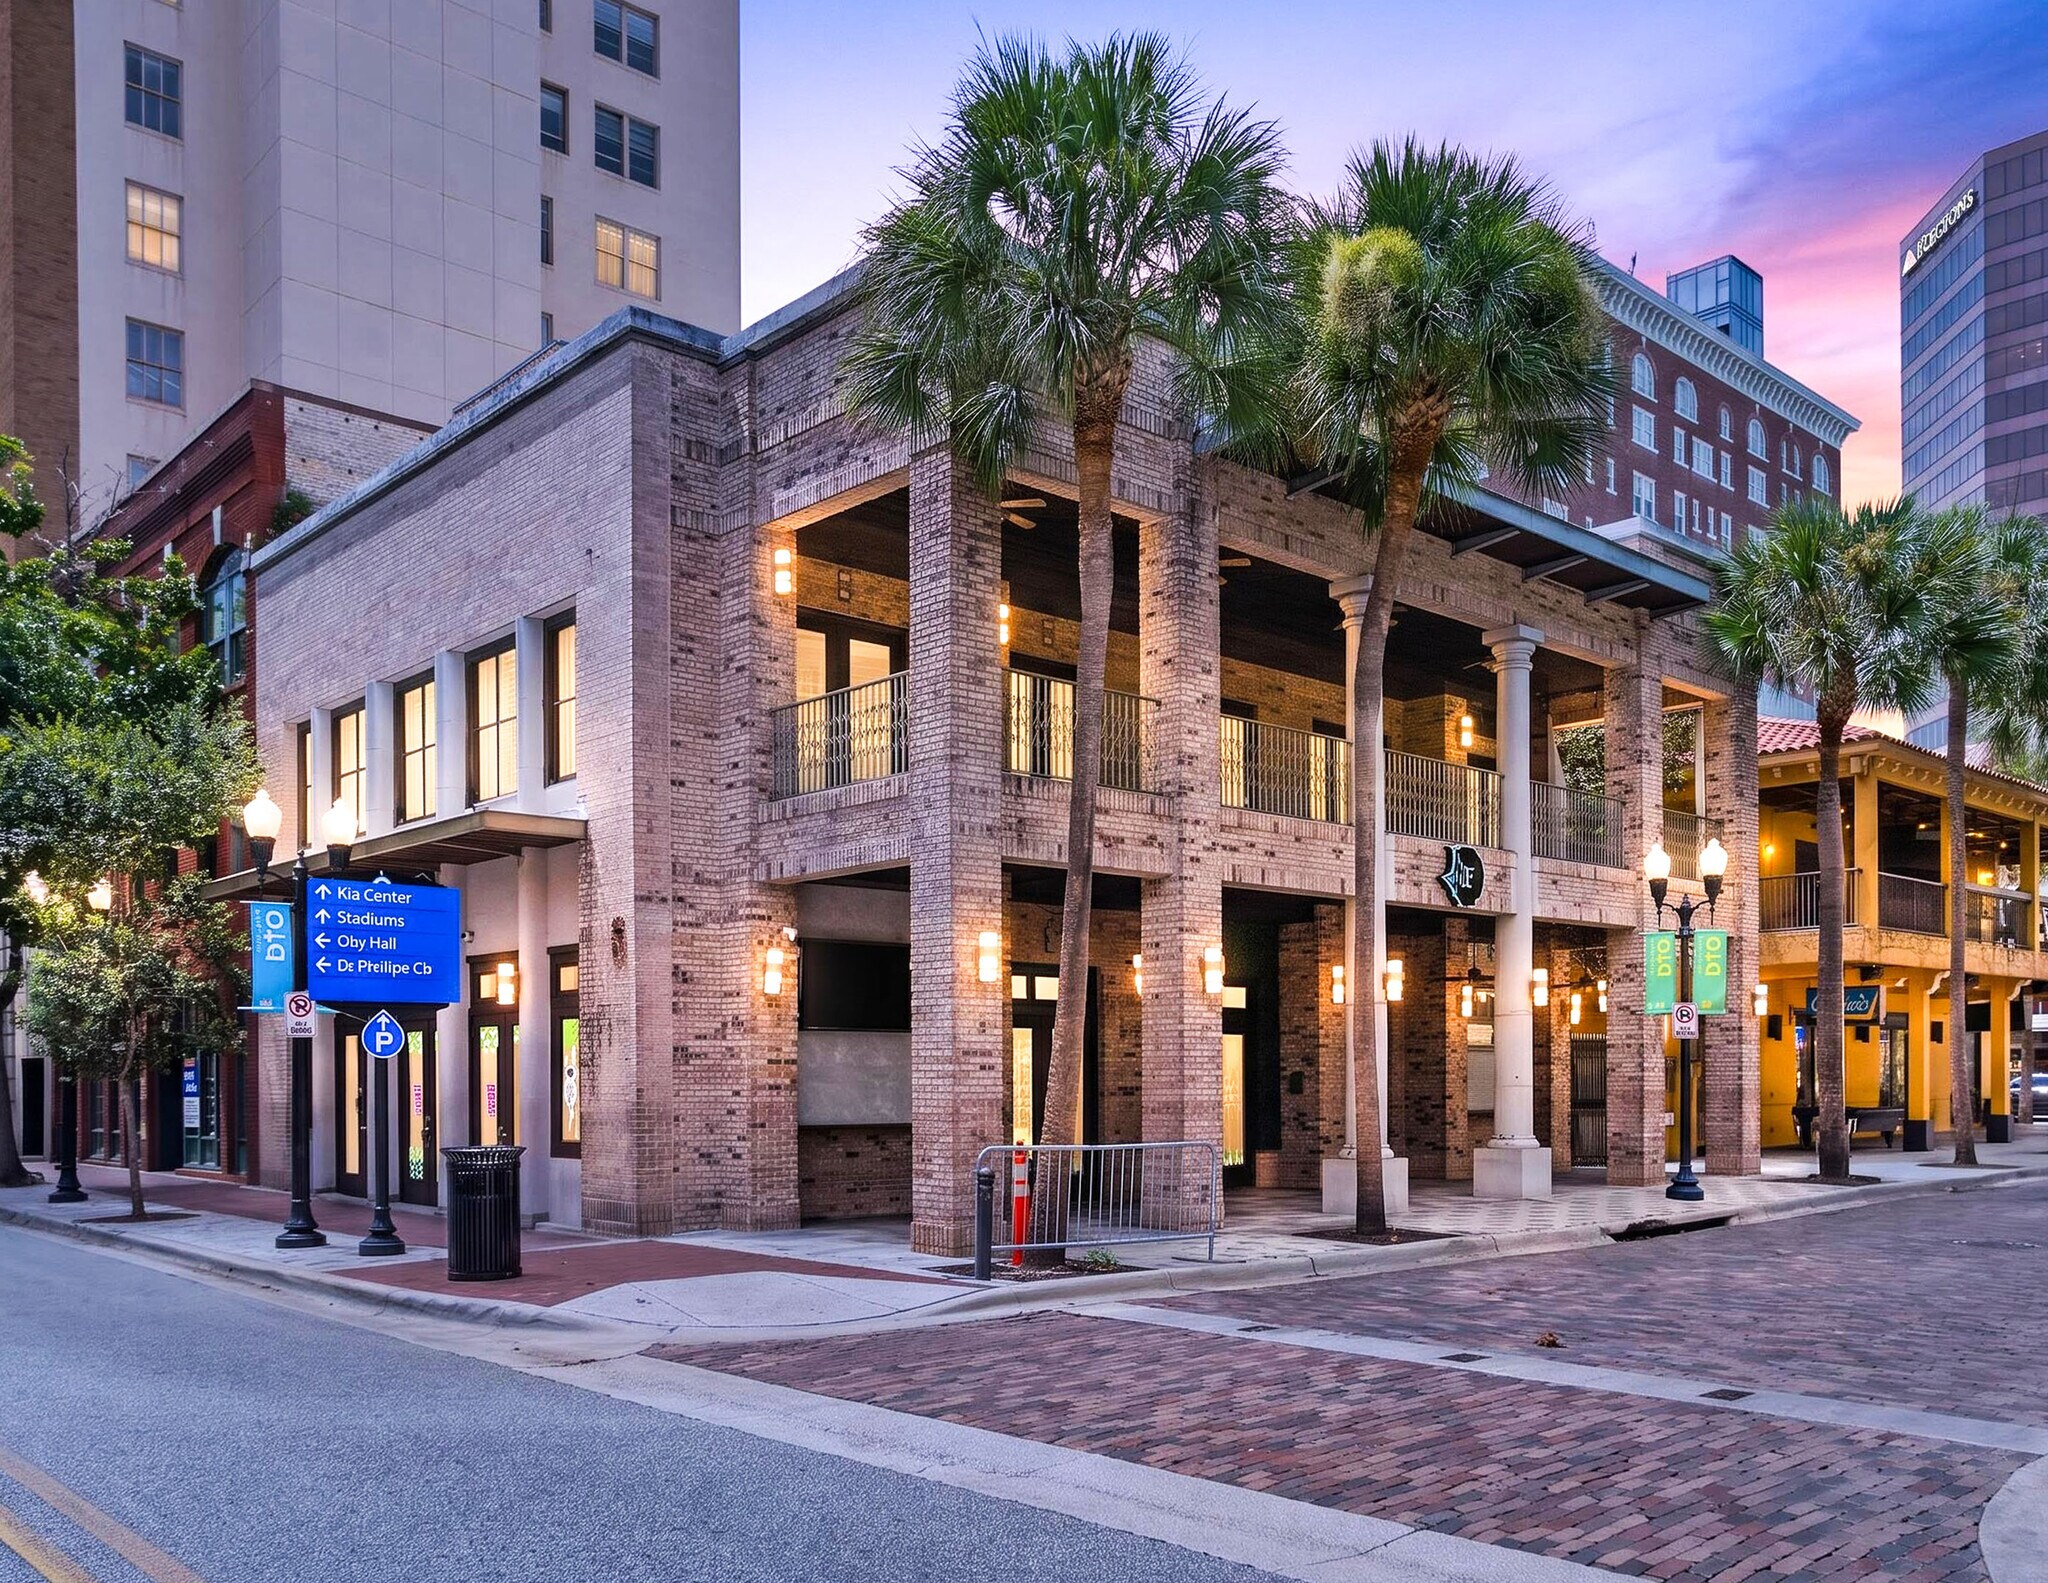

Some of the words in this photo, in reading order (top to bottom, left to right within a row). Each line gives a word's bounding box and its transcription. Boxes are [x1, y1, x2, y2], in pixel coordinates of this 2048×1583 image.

[337, 886, 360, 901] Kia
[363, 888, 412, 904] Center
[337, 910, 405, 927] Stadiums
[370, 936, 397, 950] Hall
[375, 1031, 394, 1053] P
